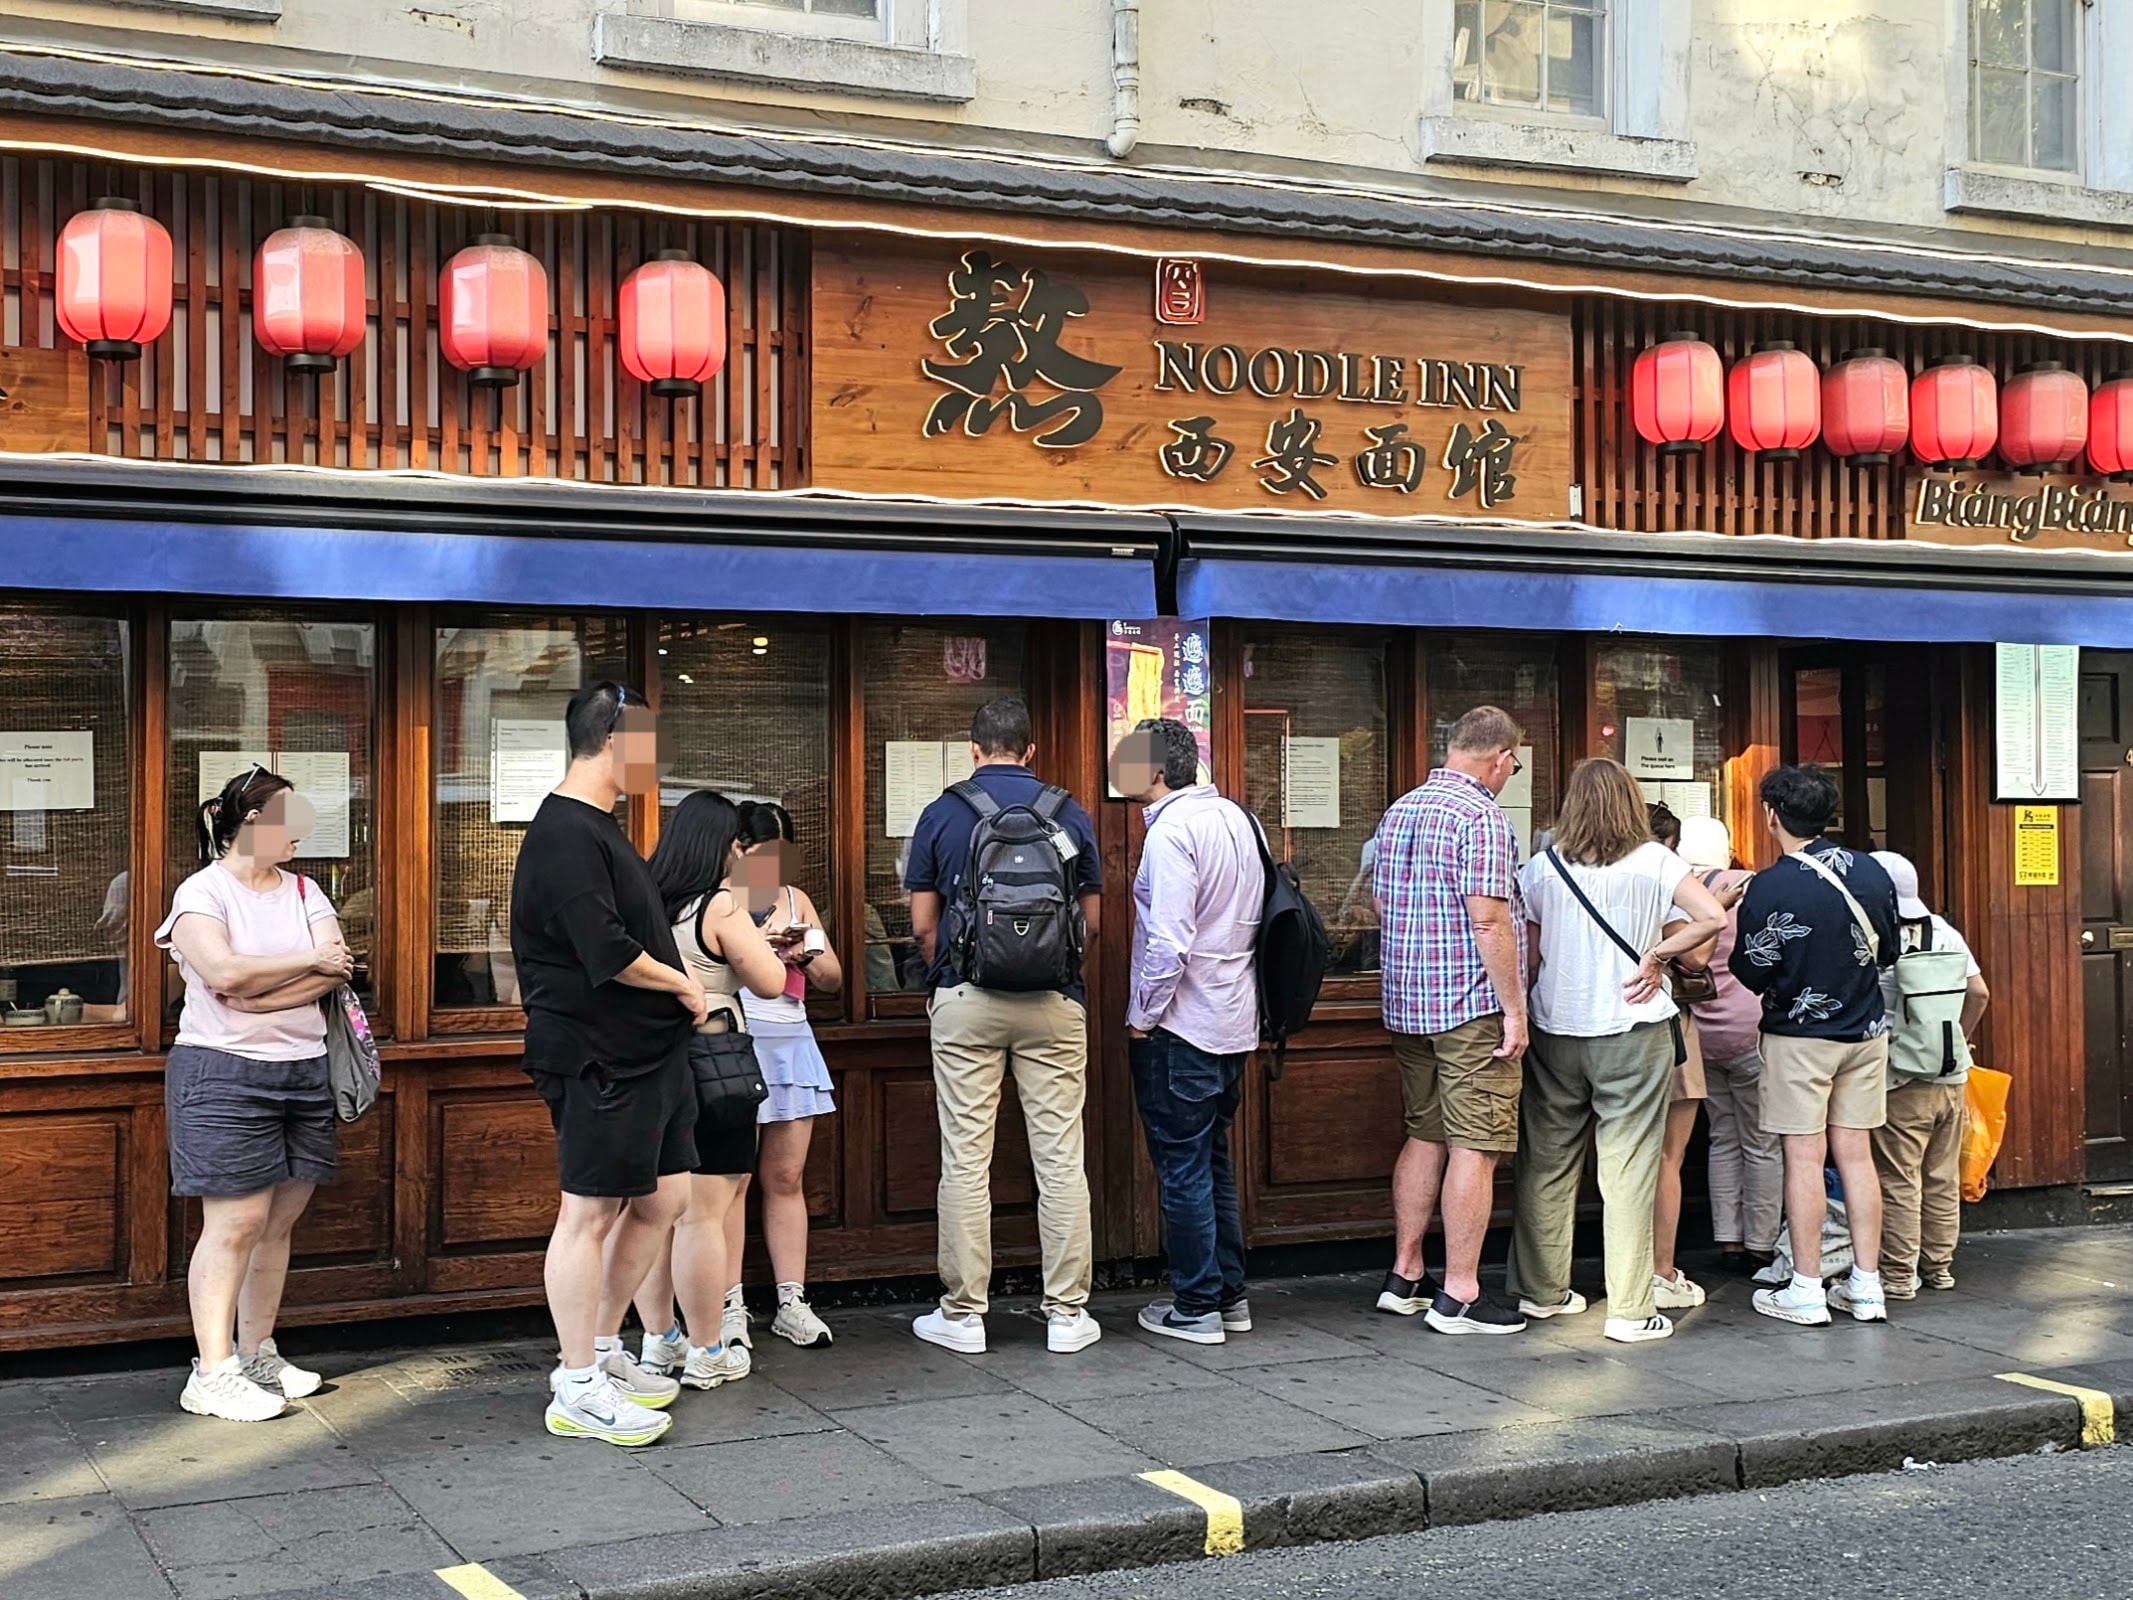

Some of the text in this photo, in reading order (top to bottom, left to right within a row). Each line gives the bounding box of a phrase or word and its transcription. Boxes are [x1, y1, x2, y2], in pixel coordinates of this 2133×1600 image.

[1154, 339, 1524, 413] NOODLE INN
[1159, 408, 1518, 509] 西安面馆
[1915, 478, 2133, 545] BiángBián
